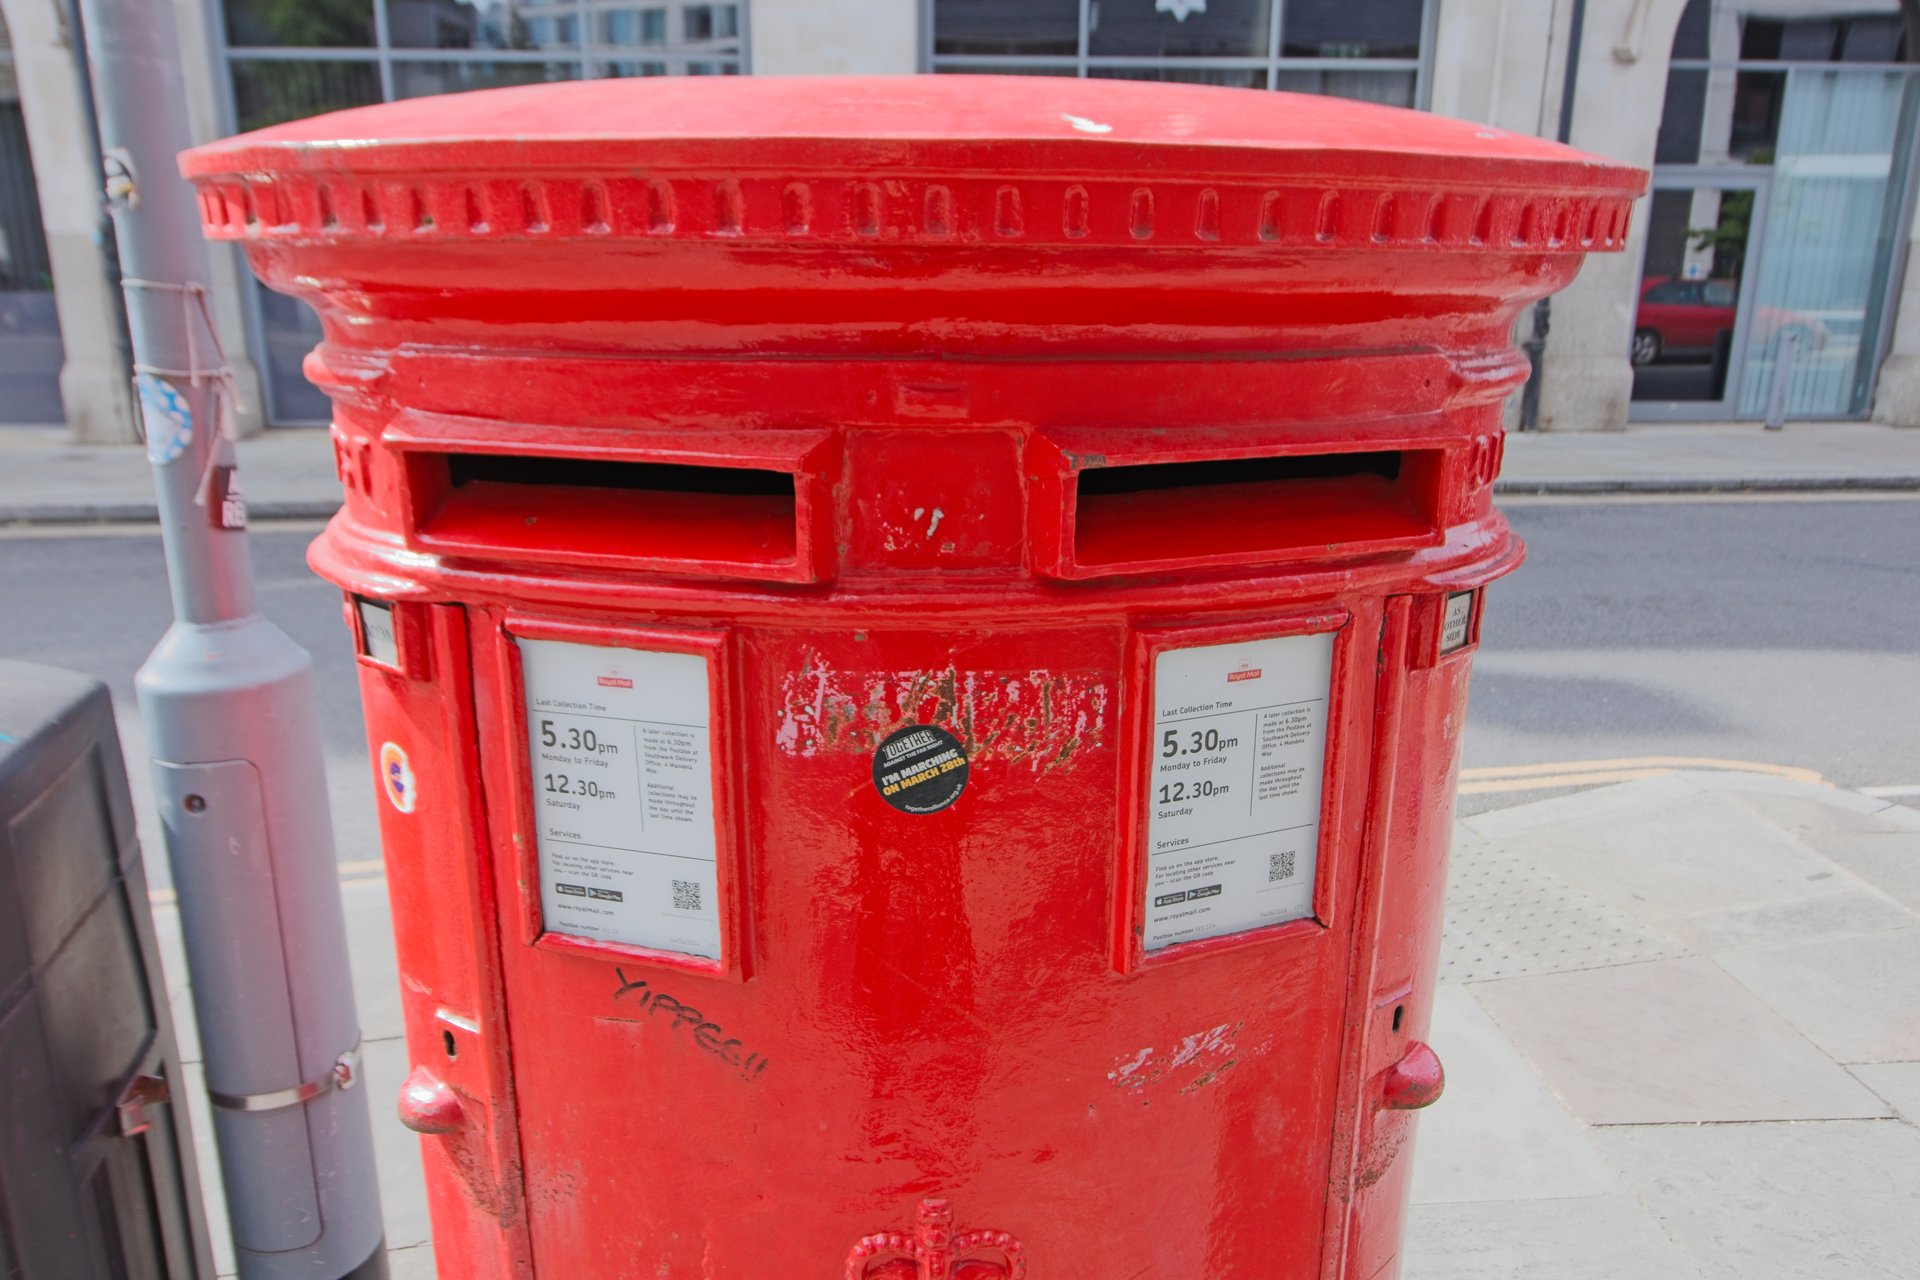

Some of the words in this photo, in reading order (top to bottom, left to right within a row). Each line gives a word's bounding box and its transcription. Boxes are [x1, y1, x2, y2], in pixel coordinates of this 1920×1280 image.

[1229, 672, 1246, 681] Royal
[536, 698, 552, 706] Last
[553, 700, 587, 710] Collection
[588, 702, 606, 712] Time
[1162, 708, 1178, 717] Last
[1180, 703, 1214, 715] Collection
[1216, 700, 1233, 710] Time
[541, 720, 618, 754] 5.30pm
[1162, 728, 1238, 758] 5.30pm
[1262, 734, 1289, 742] Southwark
[882, 730, 936, 760] TOGETHER
[542, 752, 572, 764] Monday
[584, 757, 608, 768] Friday
[884, 756, 906, 768] AGAINST
[928, 740, 944, 750] RIGHT
[882, 772, 901, 786] I'M
[900, 748, 959, 779] MARCHING
[1160, 761, 1191, 772] Monday
[1193, 759, 1201, 767] to
[1203, 755, 1227, 766] Friday
[1260, 762, 1286, 771] Additional
[882, 783, 900, 796] ON
[900, 767, 940, 789] MARCH
[940, 757, 966, 773] 28th
[1260, 770, 1286, 779] collections
[1275, 774, 1302, 784] throughout
[544, 773, 616, 800] 12.30pm
[1159, 780, 1229, 805] 12.30pm
[546, 798, 581, 811] Saturday
[1158, 806, 1193, 820] Saturday
[549, 828, 582, 840] Services
[1156, 836, 1190, 850] Services
[1166, 868, 1186, 877] locating
[1154, 906, 1211, 923] www.royalmail.com
[1153, 933, 1173, 941] Postbox
[1174, 928, 1194, 936] number
